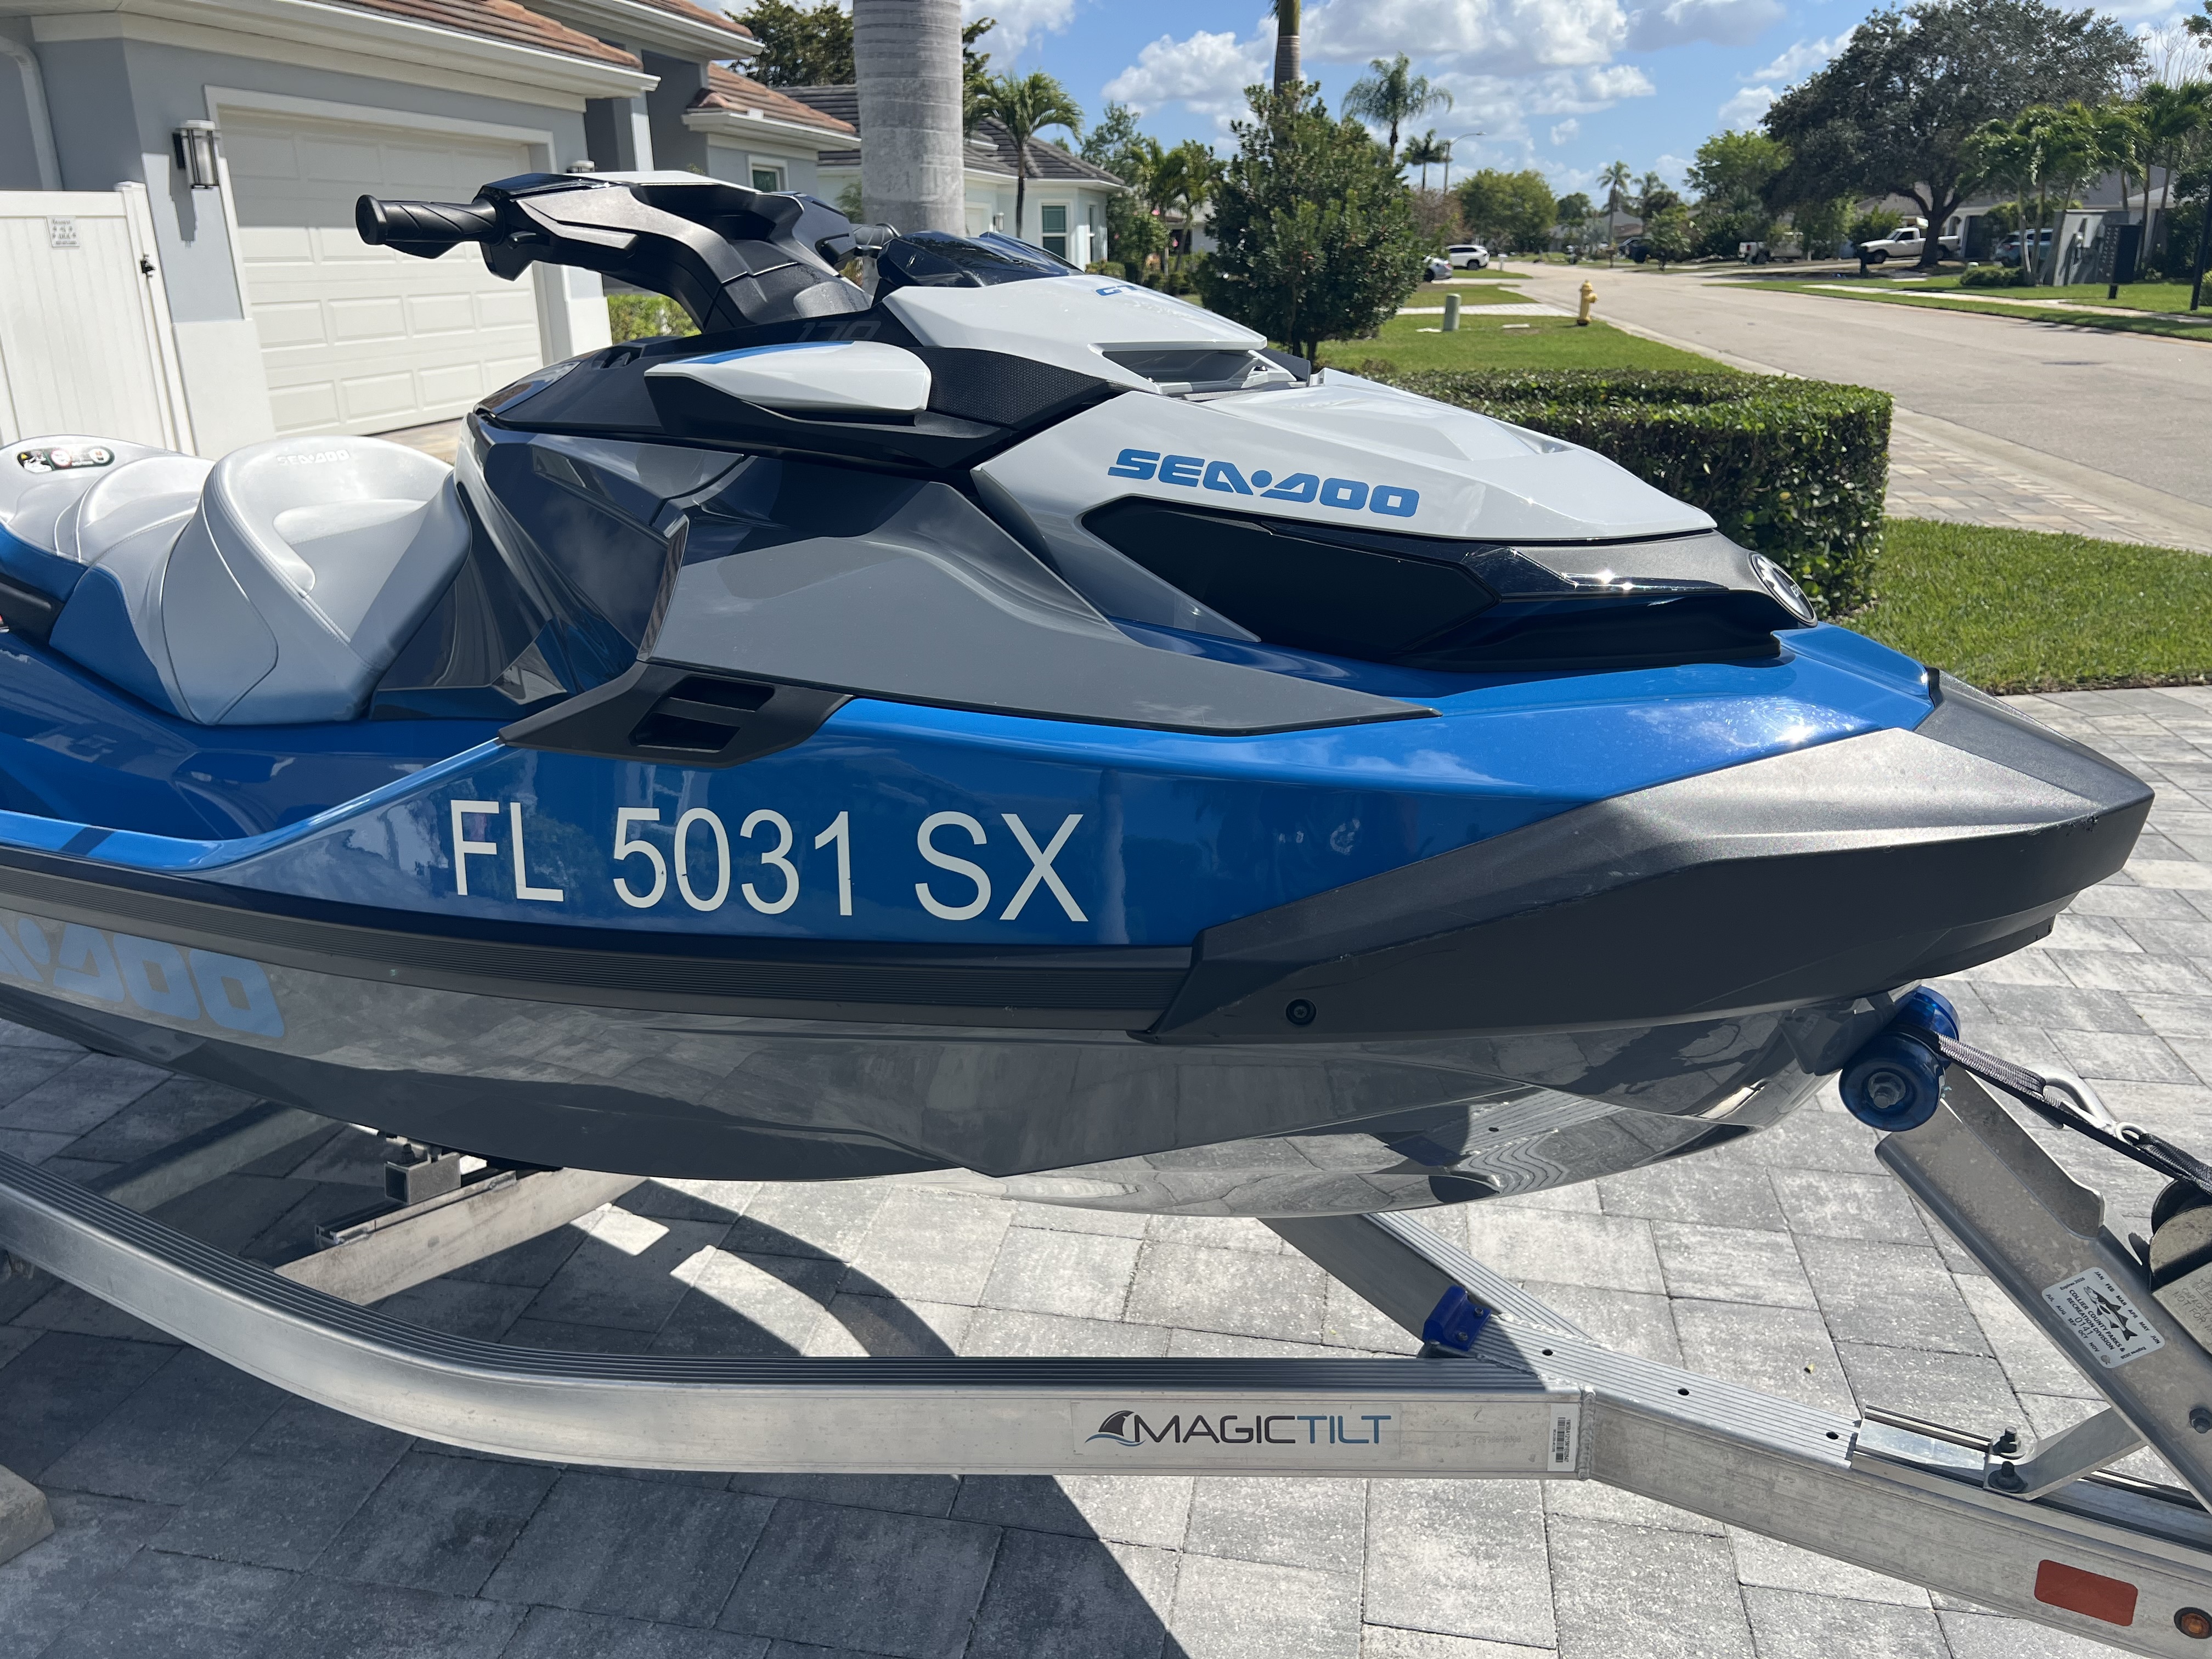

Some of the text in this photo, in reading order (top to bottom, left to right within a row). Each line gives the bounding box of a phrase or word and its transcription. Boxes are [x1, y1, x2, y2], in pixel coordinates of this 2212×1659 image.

[796, 320, 881, 343] 170
[450, 800, 1089, 922] FL 5031 SX
[2056, 1305, 2067, 1315] AUG
[2067, 1318, 2076, 1326] SEP
[2078, 1329, 2088, 1339] OCT
[2089, 1342, 2100, 1352] NOV
[2067, 1297, 2115, 1350] RECREATION DIVISION
[2069, 1290, 2089, 1310] COLLIER
[2088, 1311, 2108, 1331] COUNTY
[2106, 1331, 2122, 1347] PARKS
[2074, 1317, 2094, 1335] 0141
[2094, 1272, 2161, 1344] JAN FEB MAR APR MAY JUN
[2172, 1291, 2192, 1306] NOT
[2189, 1308, 2206, 1324] FOR
[1134, 1415, 1392, 1444] MAGICTILT
